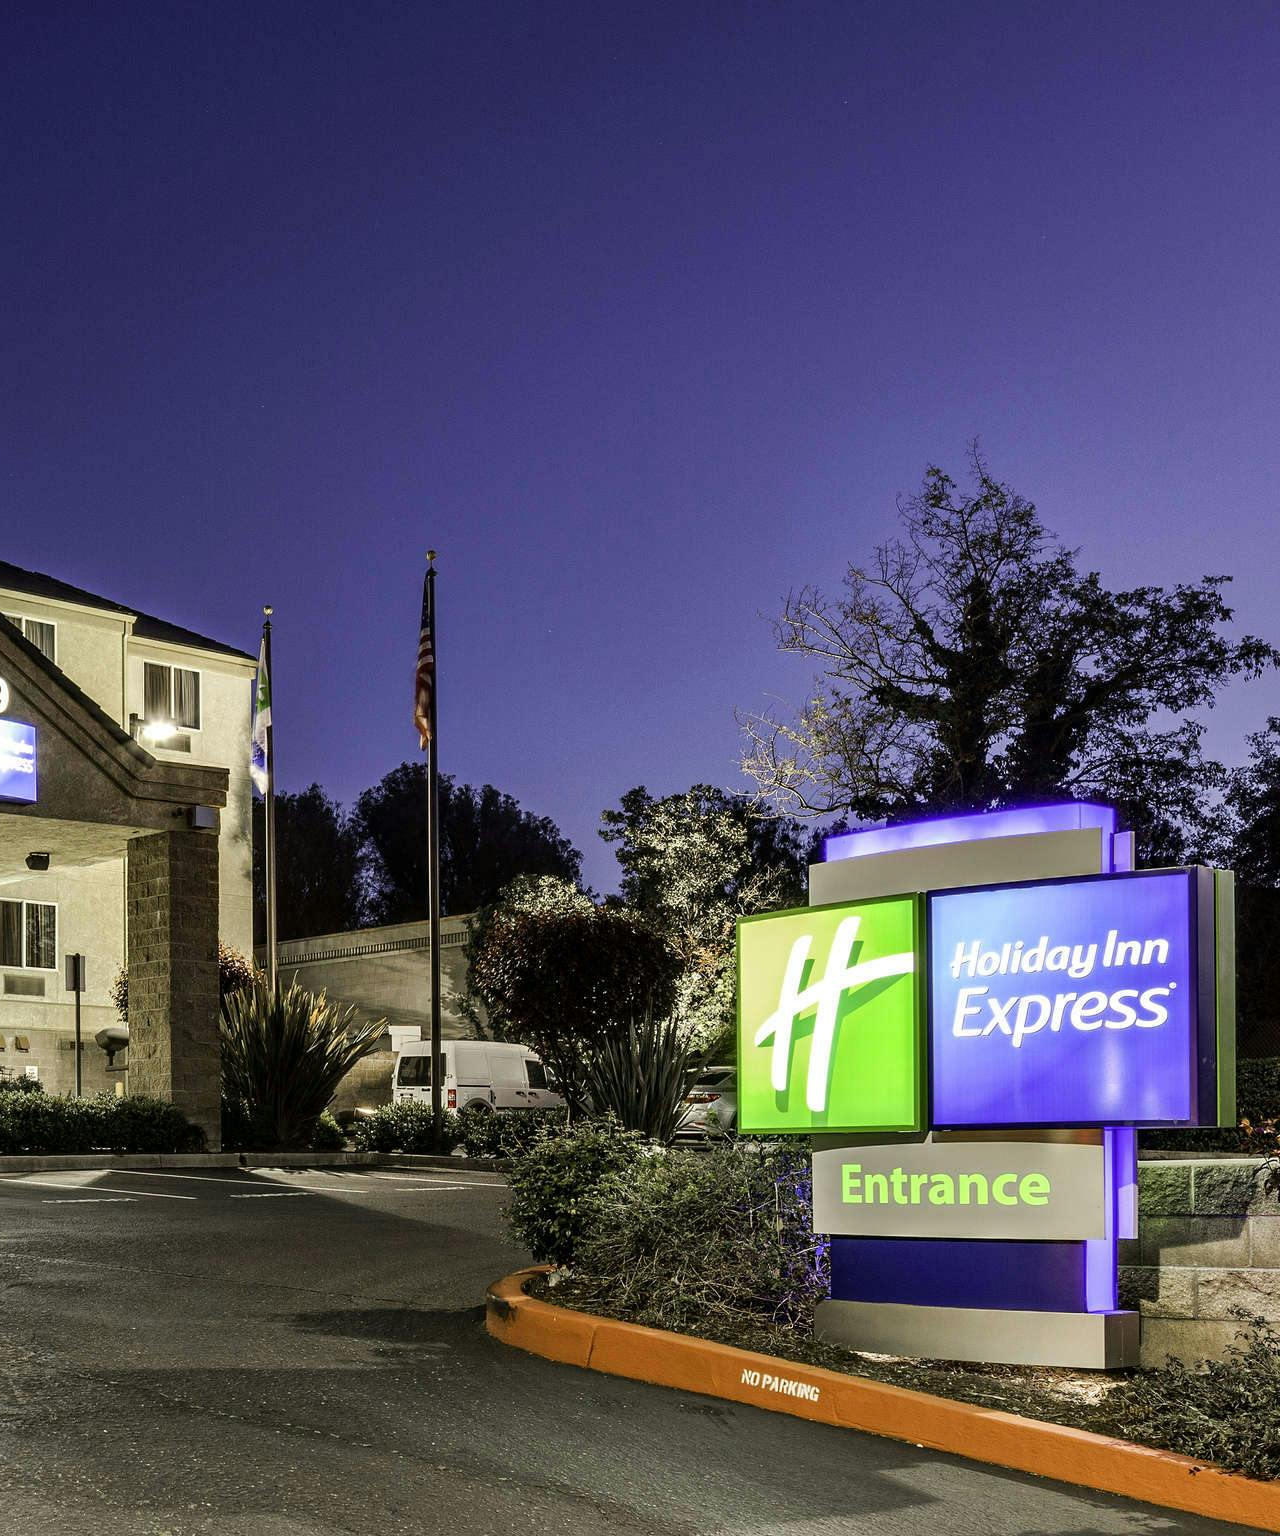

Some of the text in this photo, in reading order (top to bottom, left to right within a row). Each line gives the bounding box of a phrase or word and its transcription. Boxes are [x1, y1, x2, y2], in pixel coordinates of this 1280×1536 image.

[950, 929, 1170, 979] Holiday Inn
[754, 916, 915, 1112] H
[952, 982, 1171, 1049] Express
[841, 1163, 1052, 1207] Entrance
[742, 1369, 820, 1402] NO PARKING
